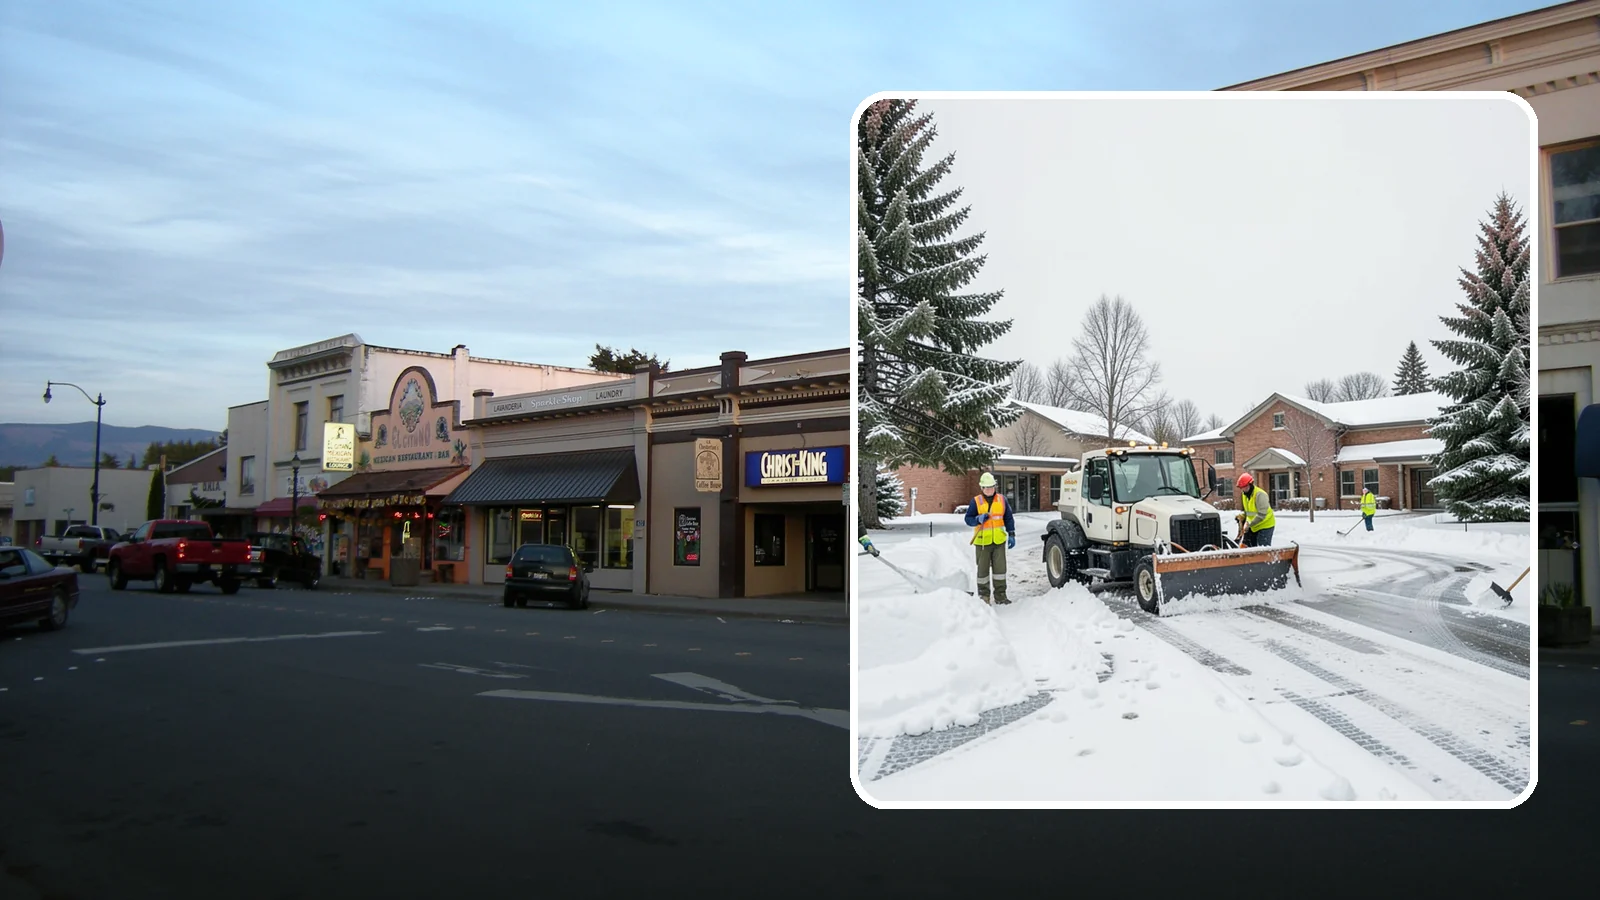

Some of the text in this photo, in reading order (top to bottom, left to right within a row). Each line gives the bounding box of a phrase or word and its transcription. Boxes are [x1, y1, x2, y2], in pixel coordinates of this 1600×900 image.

[596, 389, 624, 399] LAUNDRY
[494, 402, 522, 412] LAVANDERIA
[531, 394, 583, 409] Sparkle Shop
[374, 455, 396, 463] MEXICAN
[398, 451, 433, 462] RESTAURANT
[438, 450, 450, 459] BAR
[761, 450, 828, 478] CHRIST KING
